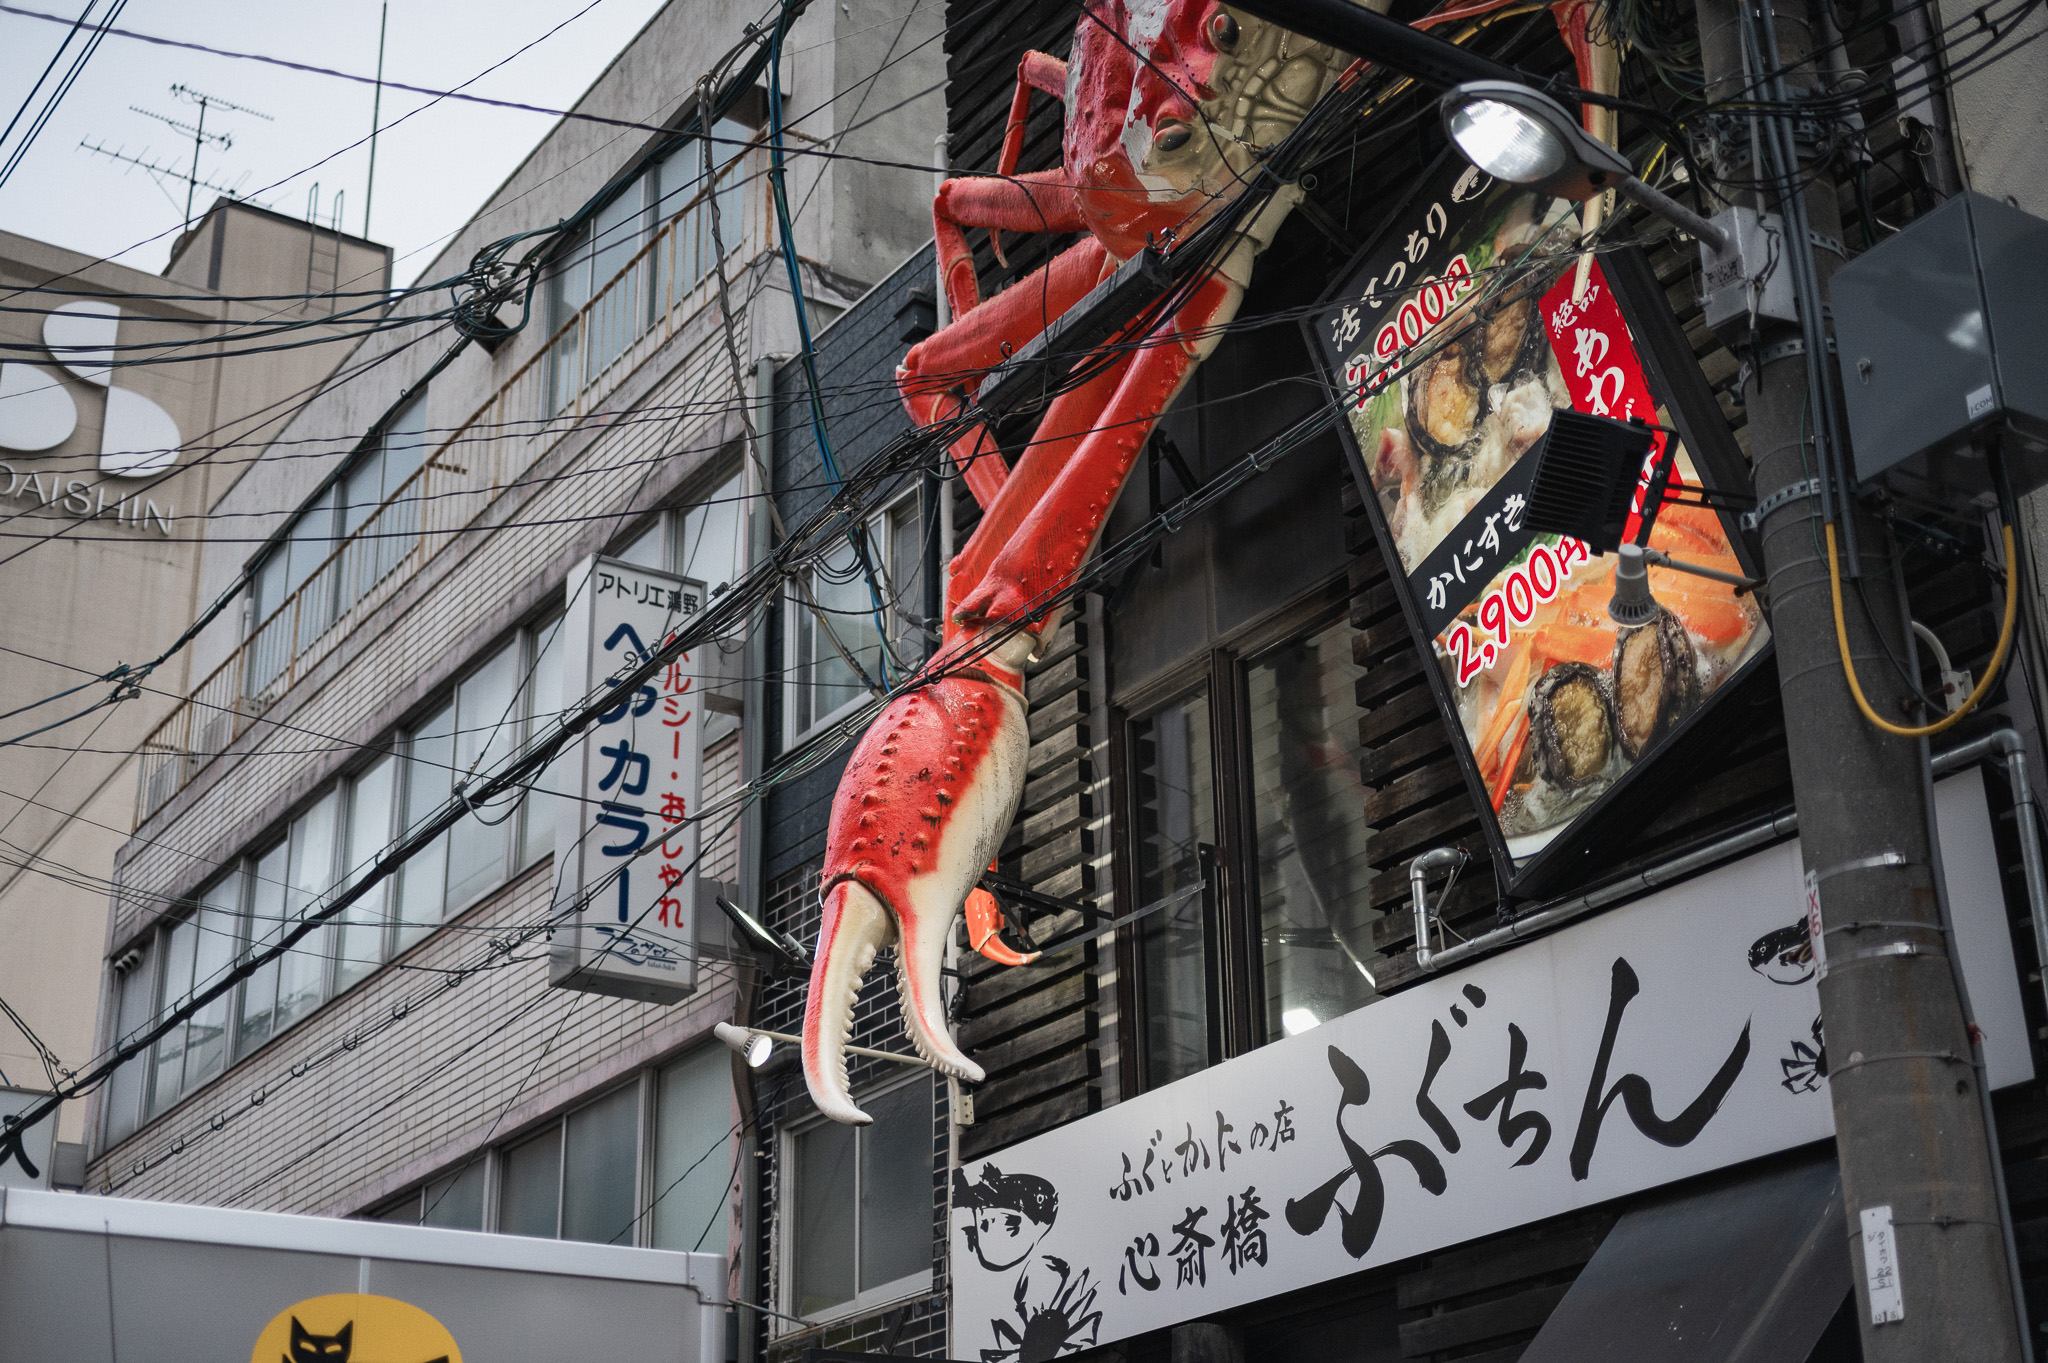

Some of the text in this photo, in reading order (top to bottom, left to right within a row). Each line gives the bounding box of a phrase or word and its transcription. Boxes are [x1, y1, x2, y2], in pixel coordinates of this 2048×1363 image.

[1427, 494, 1526, 610] かにすき
[1449, 532, 1588, 684] 2,900円
[1109, 1099, 1295, 1201] ふぐとかにの店
[1285, 956, 1753, 1261] ふぐちん
[1119, 1185, 1270, 1295] 心斎橋
